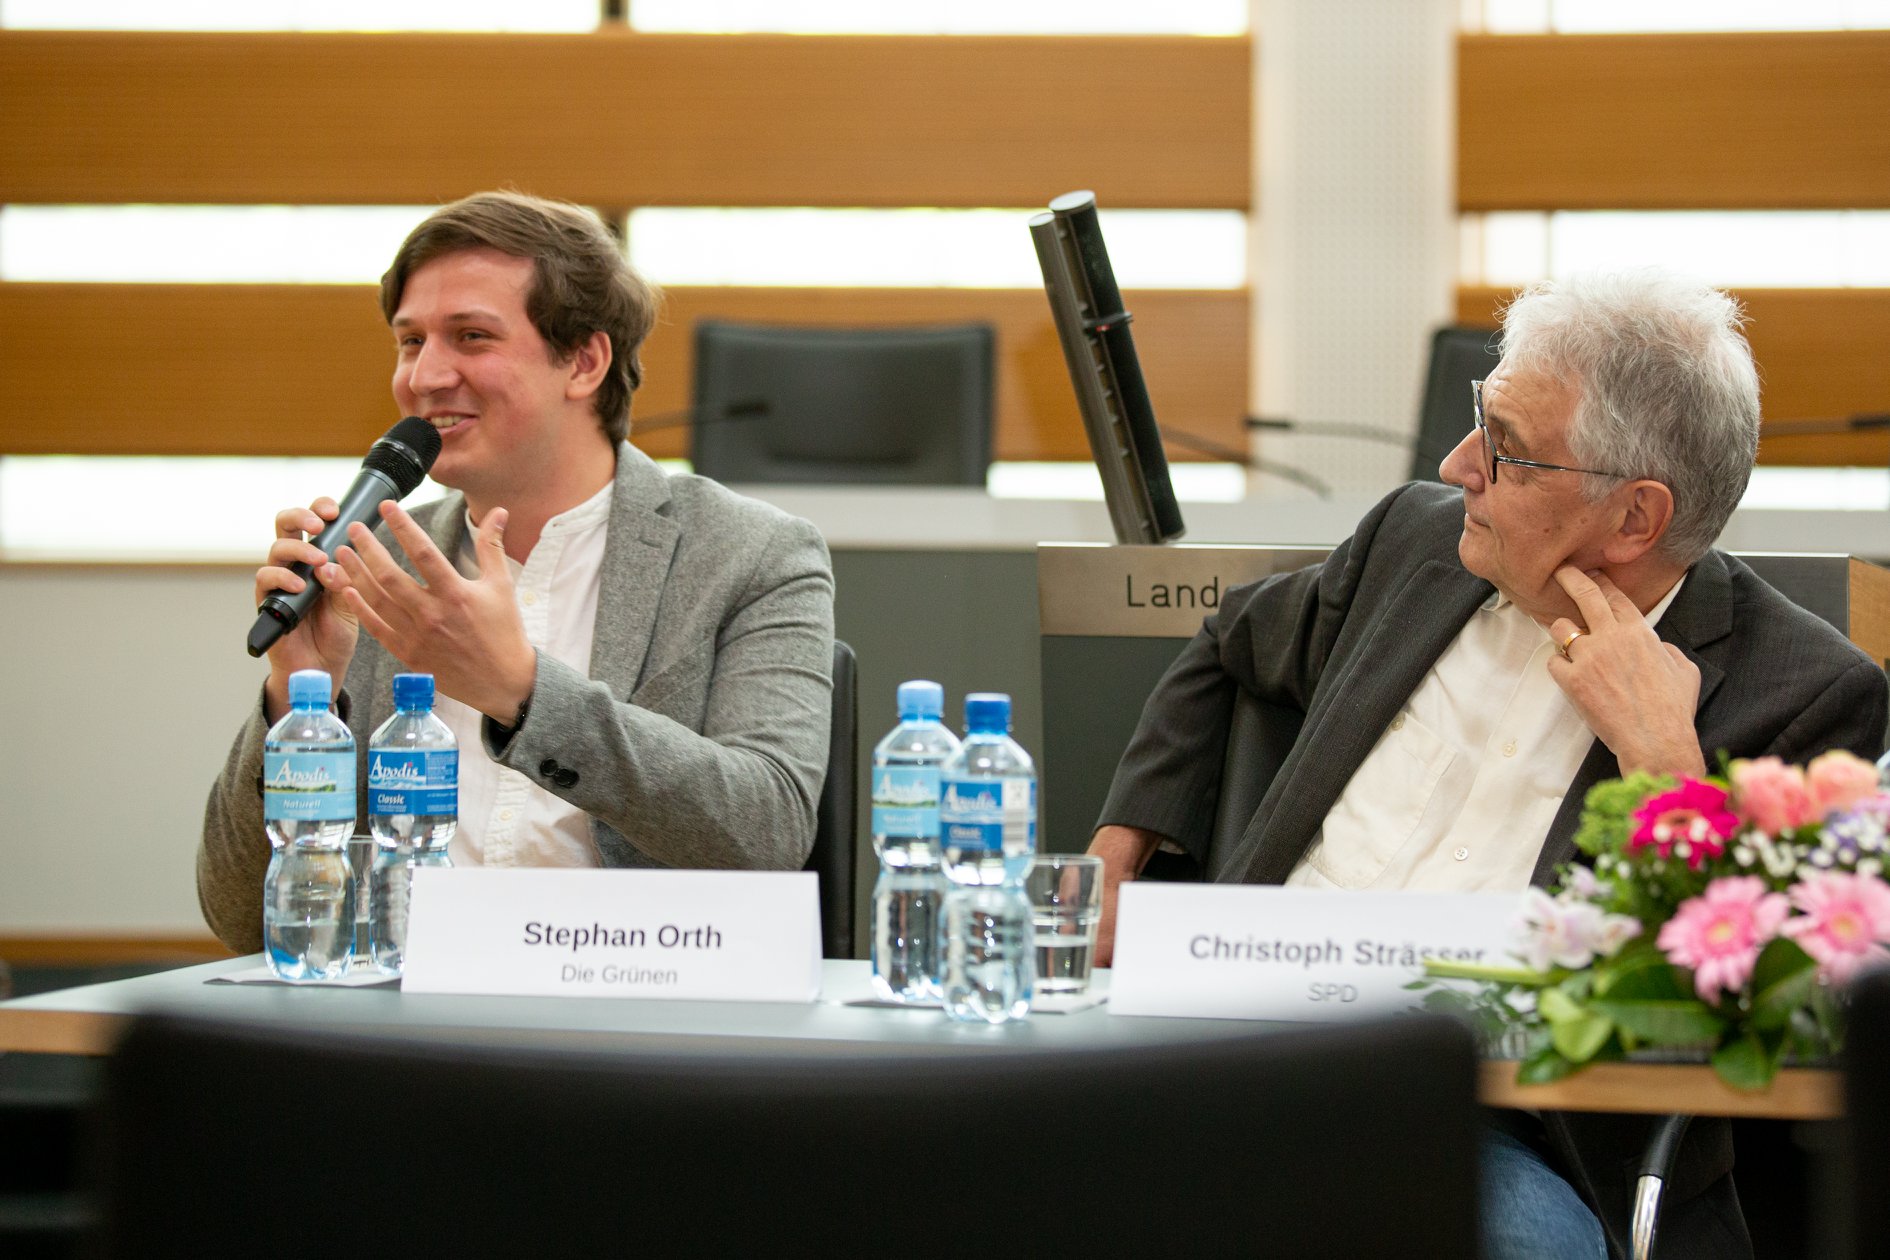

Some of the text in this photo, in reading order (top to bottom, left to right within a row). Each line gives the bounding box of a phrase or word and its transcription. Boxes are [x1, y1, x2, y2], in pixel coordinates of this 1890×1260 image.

[1126, 574, 1219, 608] Land
[370, 754, 419, 782] Apodis
[523, 921, 722, 952] Stephan Orth
[1189, 934, 1343, 968] Christoph
[561, 964, 678, 985] Die Grünen
[1307, 983, 1359, 1003] SPD
